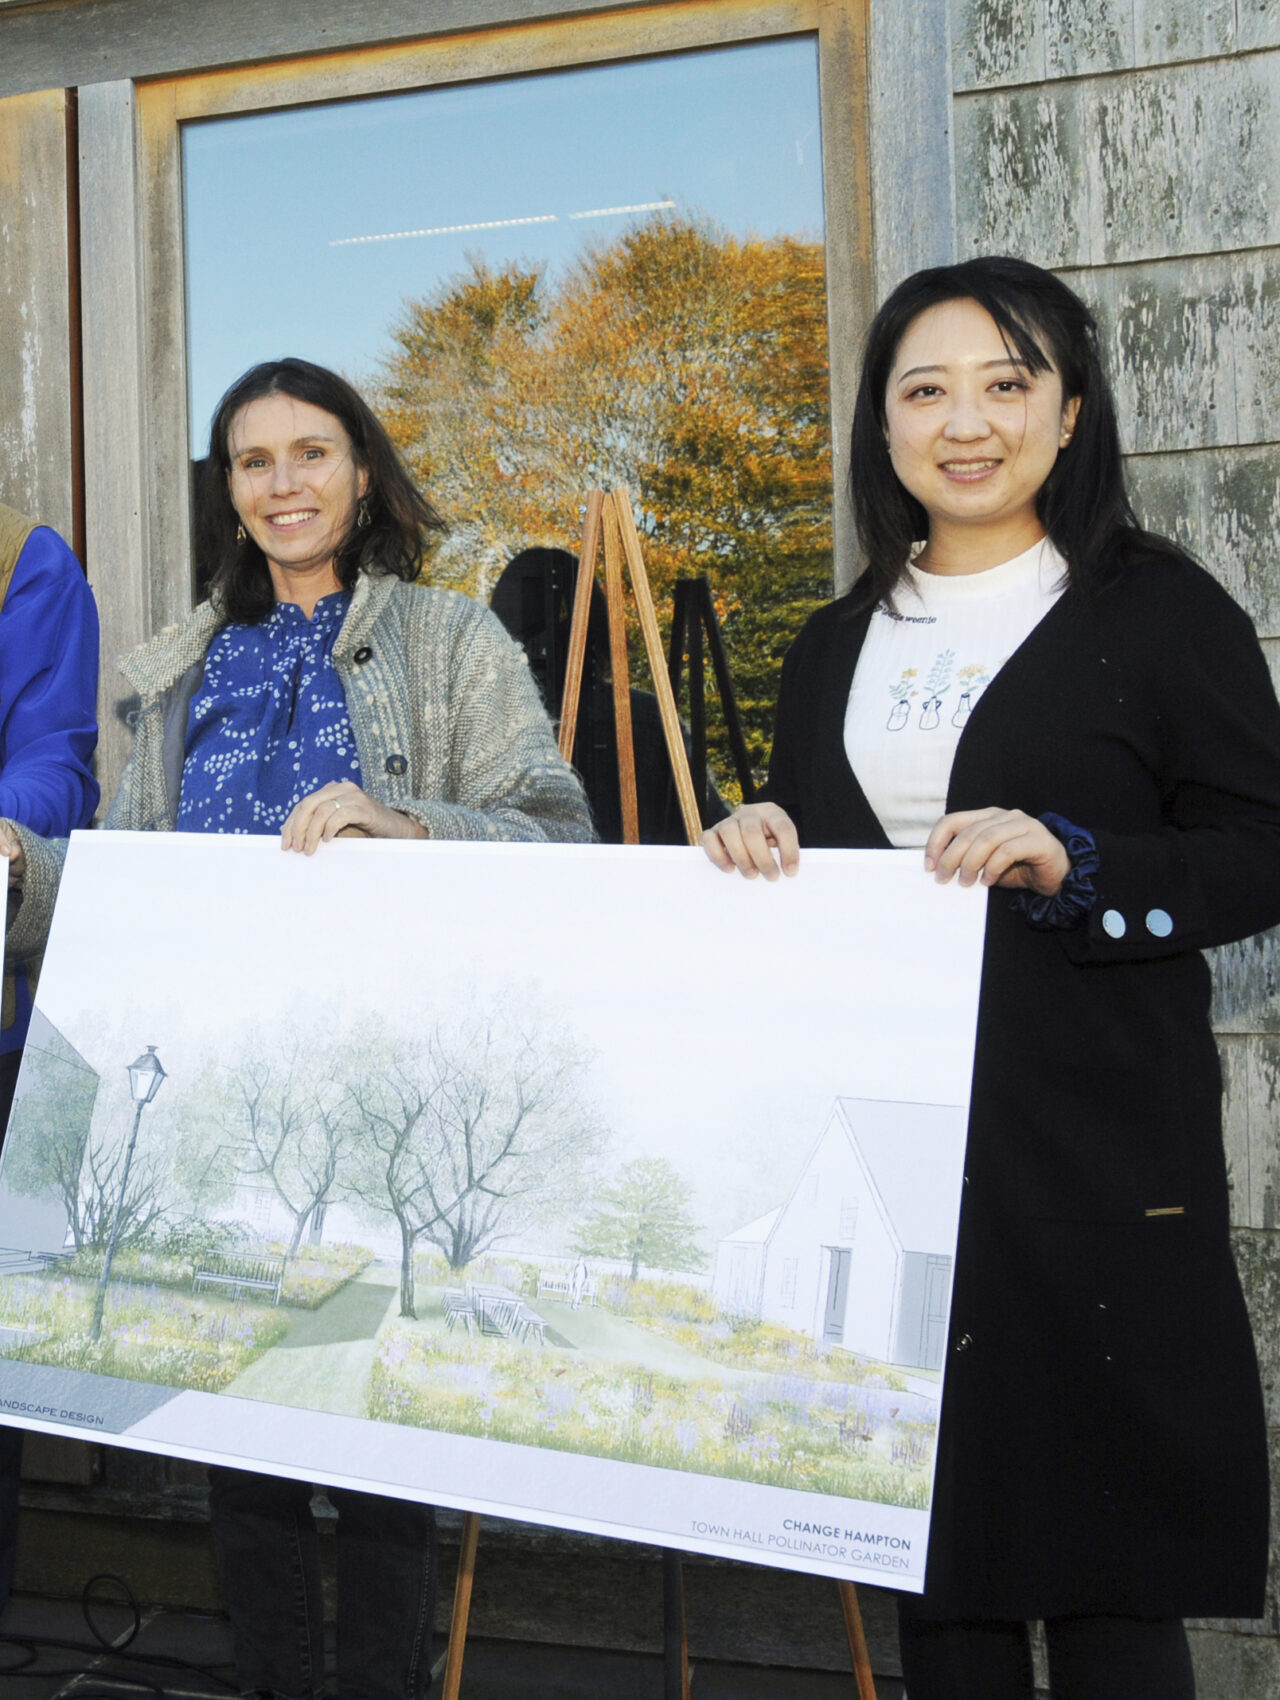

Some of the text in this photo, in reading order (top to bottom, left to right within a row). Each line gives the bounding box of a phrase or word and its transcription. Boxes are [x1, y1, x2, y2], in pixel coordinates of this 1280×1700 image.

[59, 1410, 104, 1425] DESIGN
[692, 1520, 910, 1568] TOWN HALL POLLINATOR GARDEN
[783, 1519, 911, 1550] CHANGE HAMPTON
